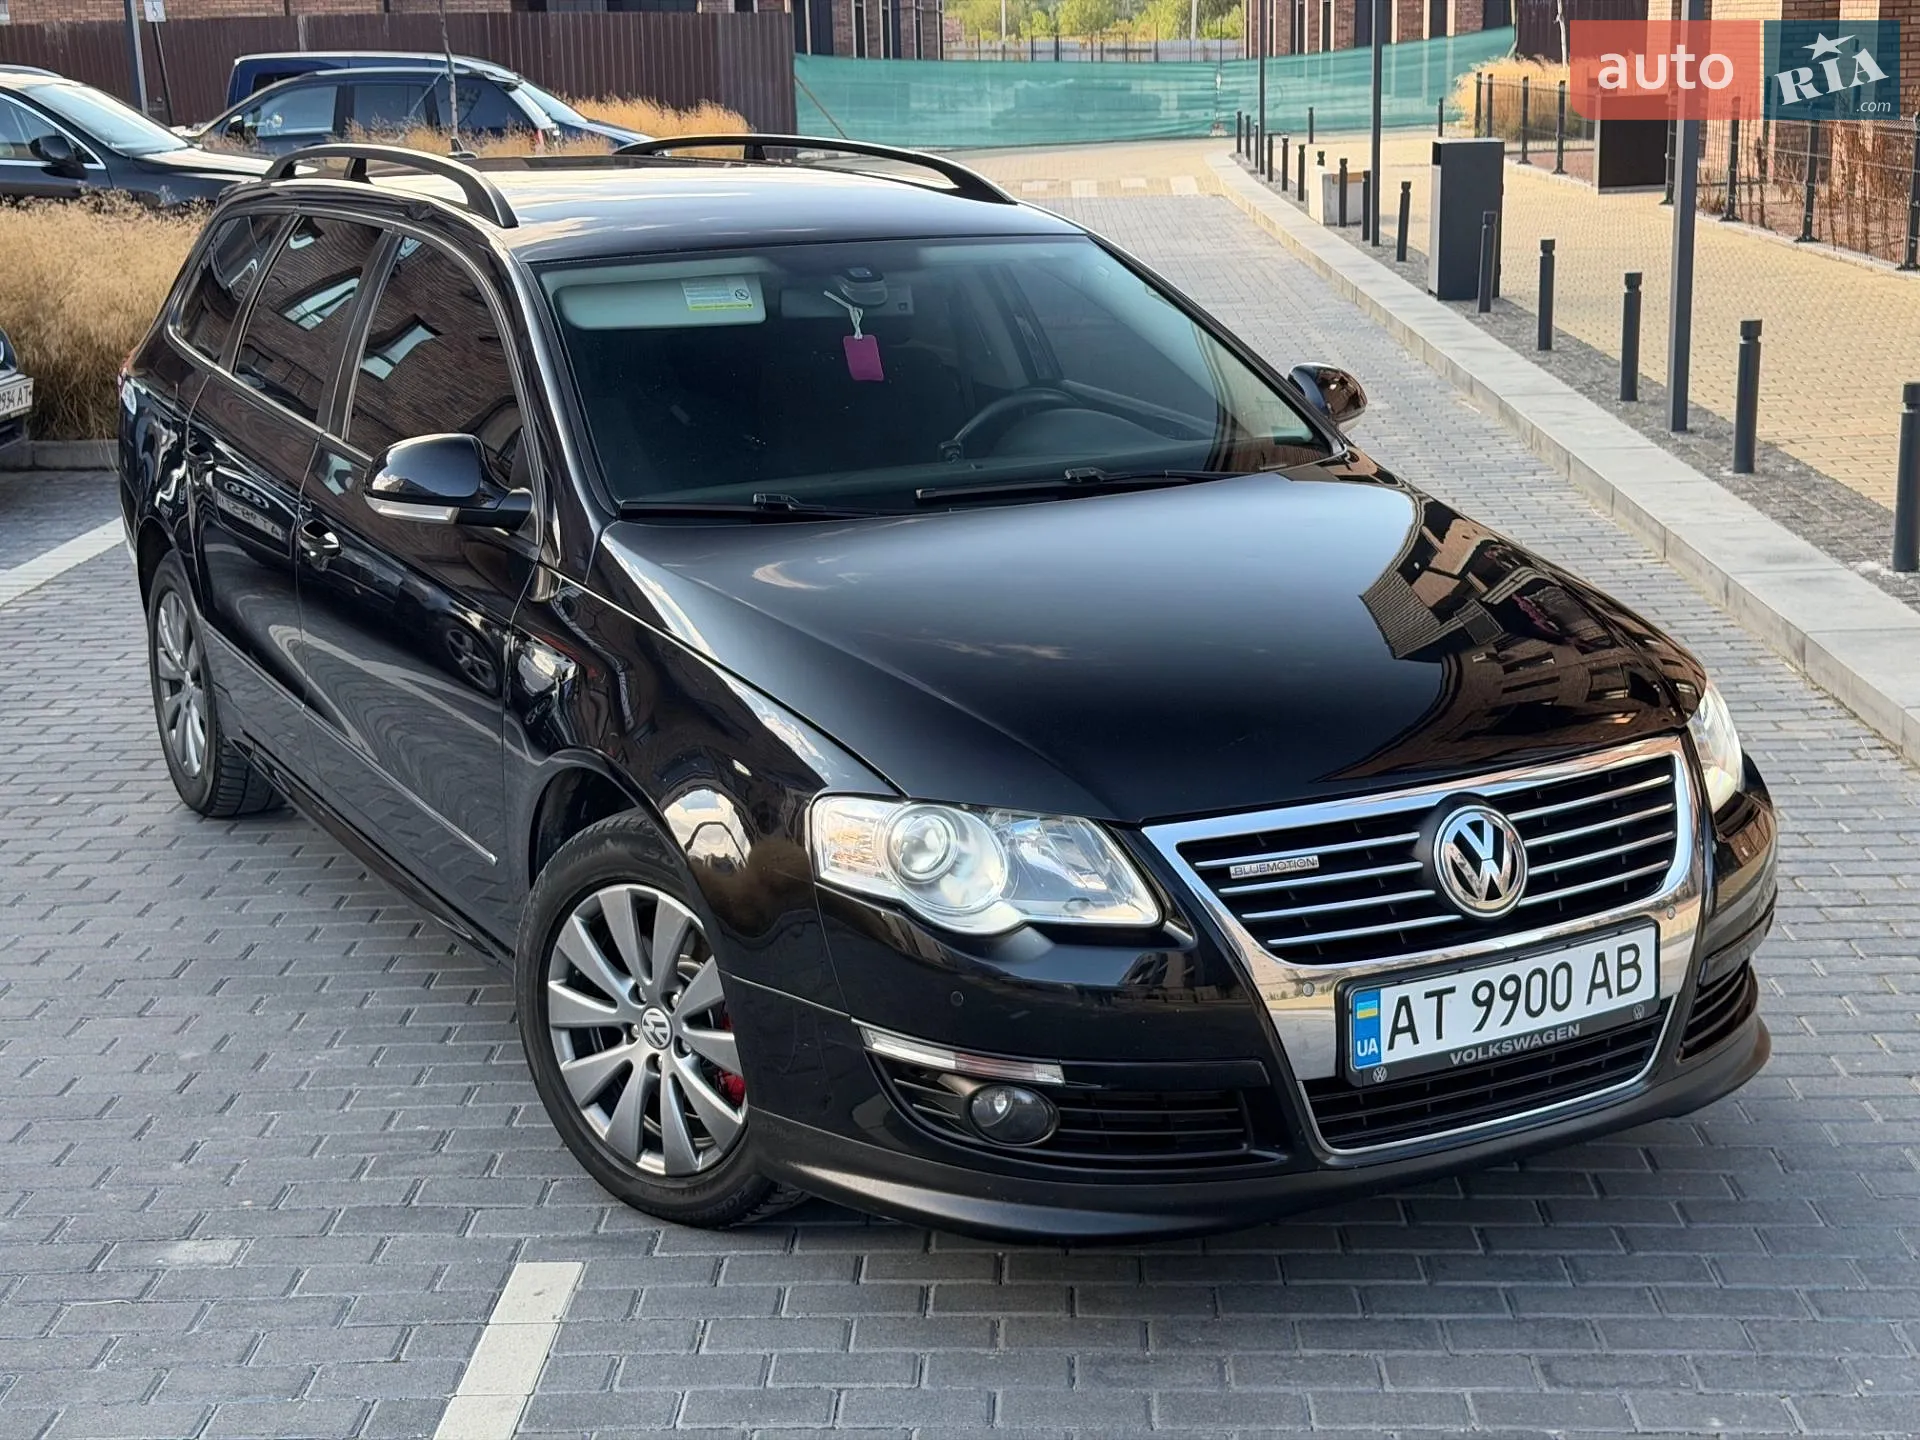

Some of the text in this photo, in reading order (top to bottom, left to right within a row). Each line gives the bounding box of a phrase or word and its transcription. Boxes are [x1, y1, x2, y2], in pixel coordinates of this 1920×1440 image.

[0, 385, 31, 412] 934 AT
[1232, 858, 1318, 876] BLUEMOTION
[1438, 808, 1525, 914] VW
[1387, 942, 1642, 1051] AT 9900 AB
[1356, 1036, 1379, 1057] UA
[1450, 1023, 1580, 1066] VOLKSWAGEN
